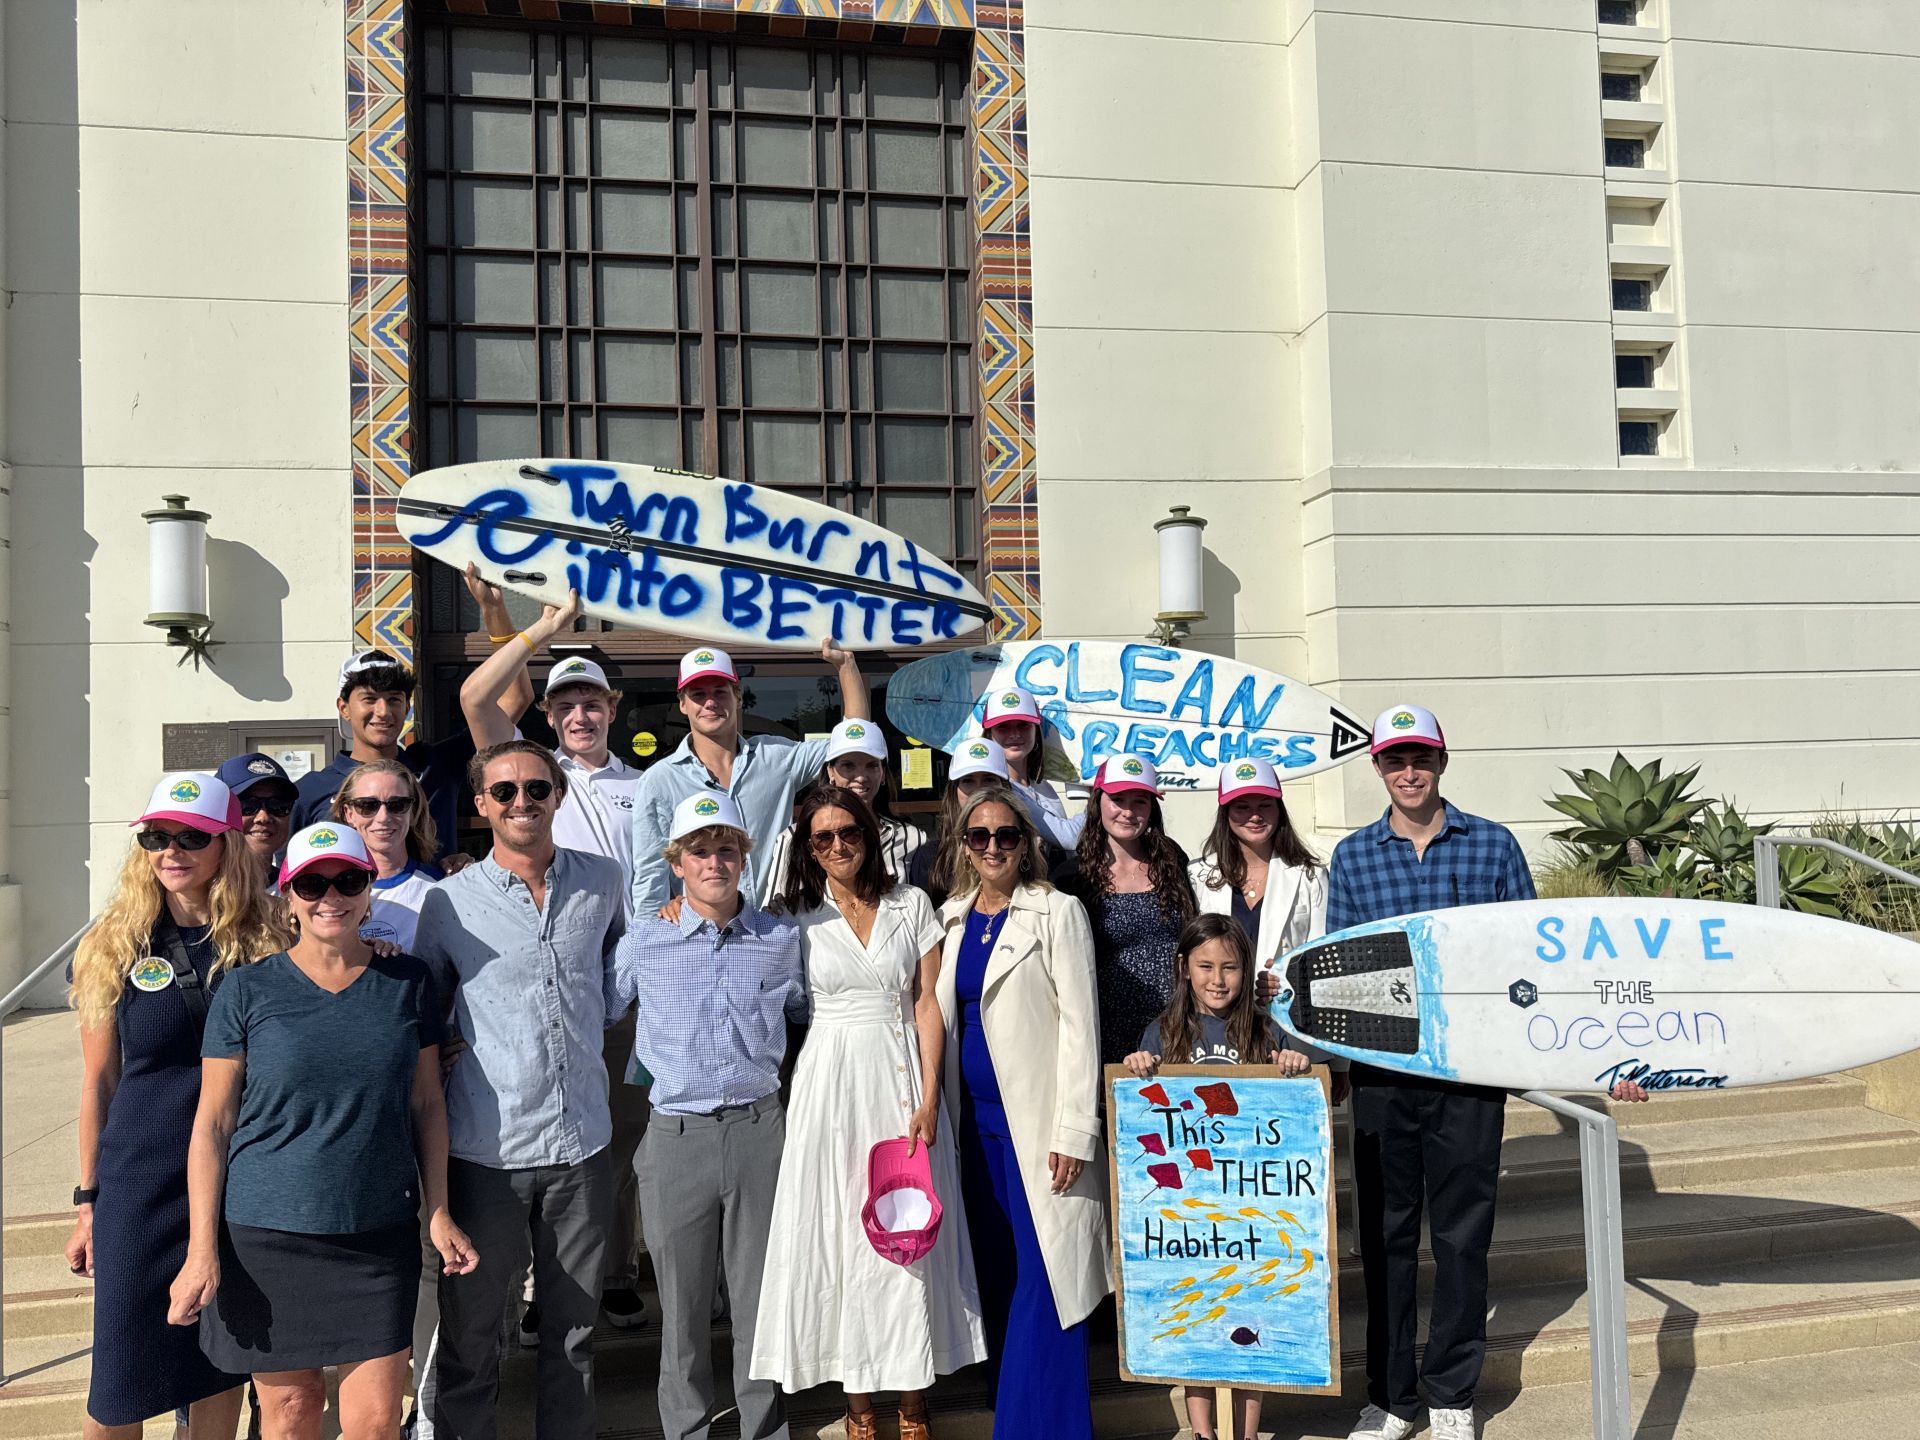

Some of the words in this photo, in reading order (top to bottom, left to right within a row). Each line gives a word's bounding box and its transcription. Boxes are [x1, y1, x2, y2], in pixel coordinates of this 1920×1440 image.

[548, 465, 698, 544] Turn
[723, 484, 962, 593] Burnt
[566, 540, 703, 616] into
[721, 567, 961, 645] BETTER
[1015, 641, 1285, 733] CLEAN
[1081, 720, 1316, 780] BEACHES
[1536, 916, 1734, 963] SAVE
[1594, 980, 1654, 1004] THE
[1151, 1107, 1226, 1149] This
[1255, 1117, 1281, 1146] is
[1213, 1159, 1316, 1197] THEIR
[1144, 1216, 1262, 1261] Habitat
